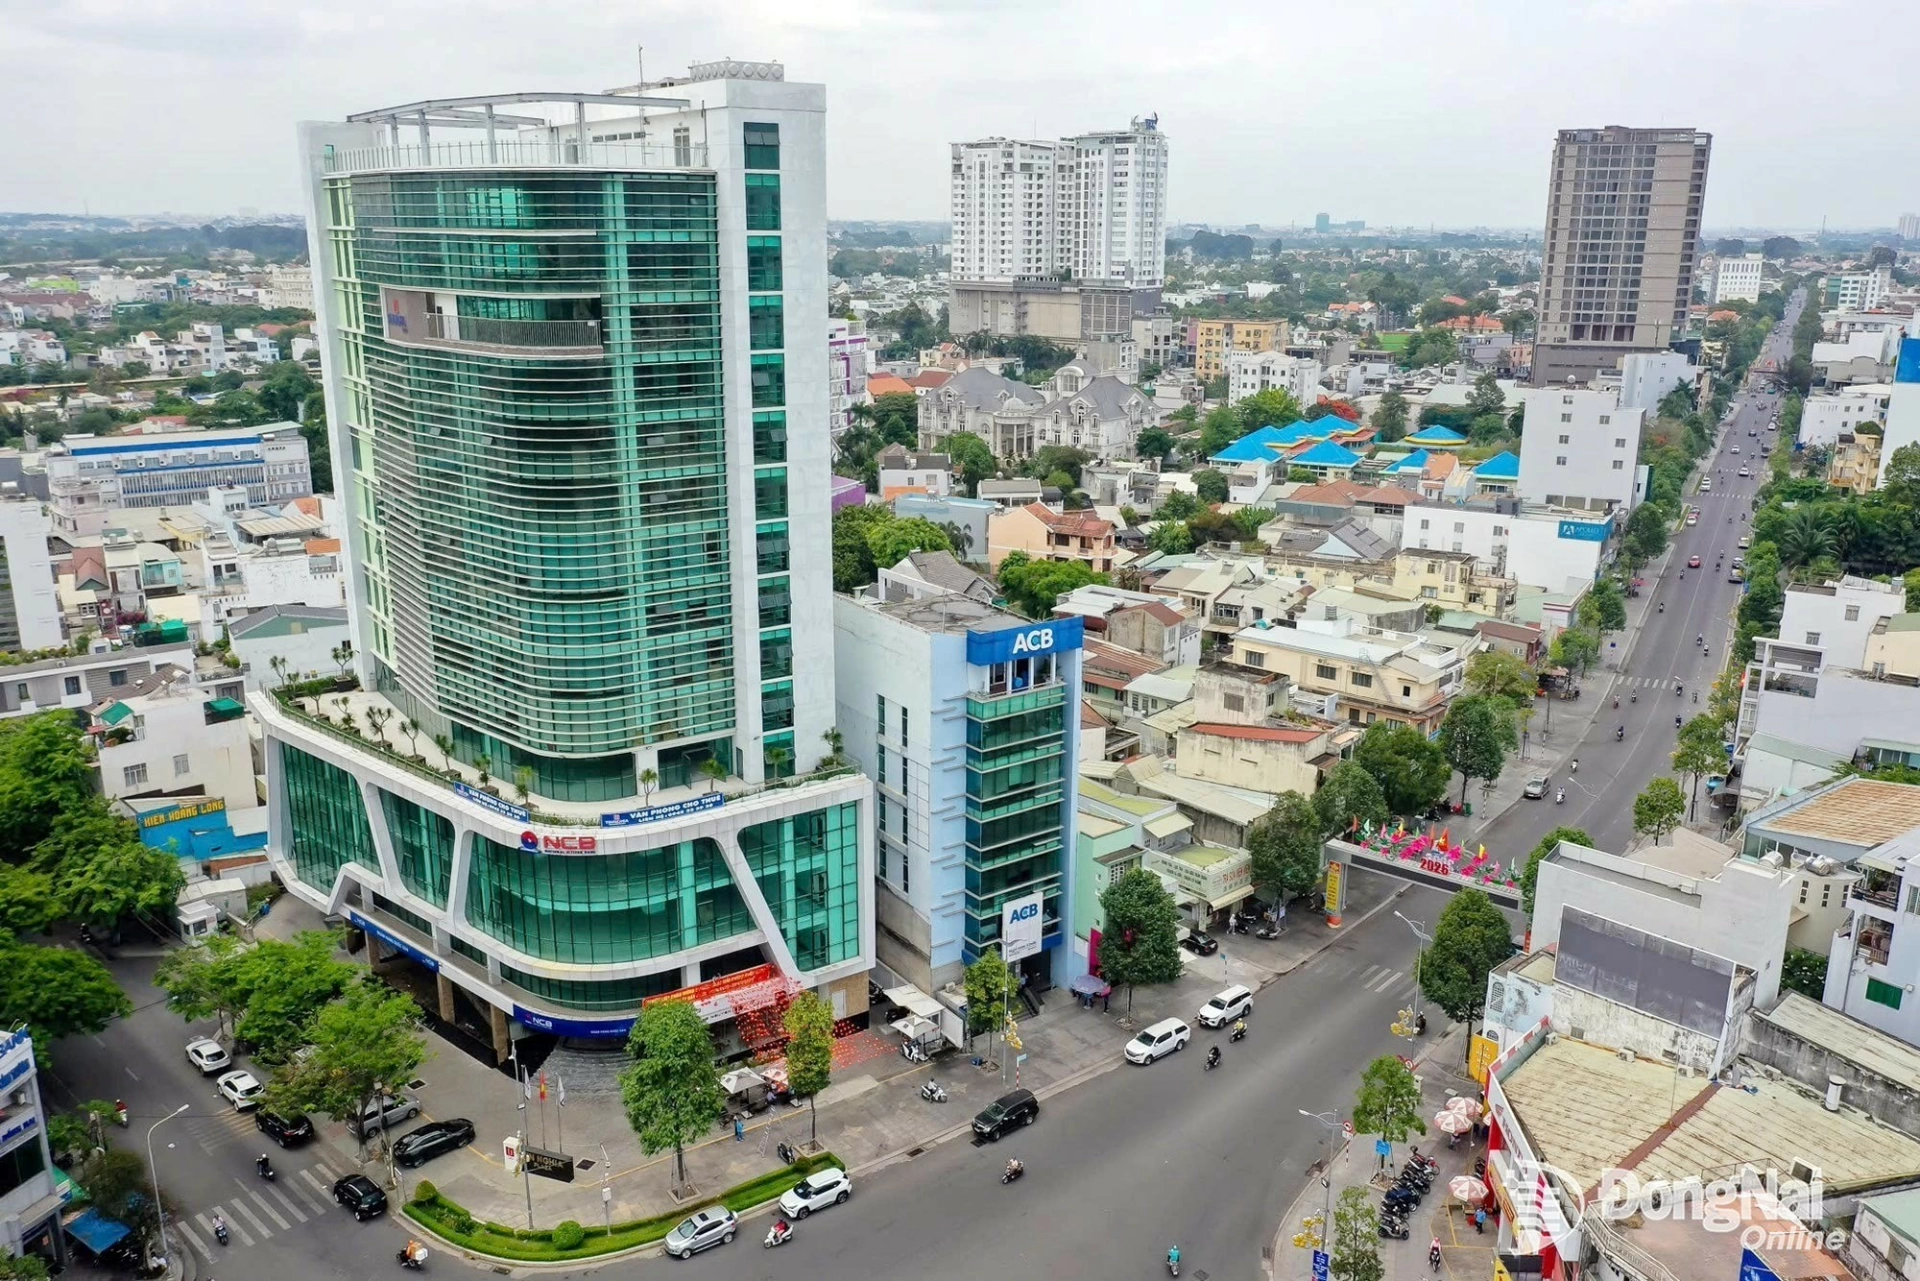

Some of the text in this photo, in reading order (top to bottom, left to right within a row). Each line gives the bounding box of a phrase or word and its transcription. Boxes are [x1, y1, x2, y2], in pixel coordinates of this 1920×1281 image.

[1013, 629, 1054, 654] ACB
[201, 800, 224, 814] LONG
[682, 800, 700, 810] CHO
[543, 835, 597, 850] NCB
[1420, 858, 1449, 876] 2026
[1009, 903, 1038, 925] ACB
[532, 1017, 553, 1028] NCB
